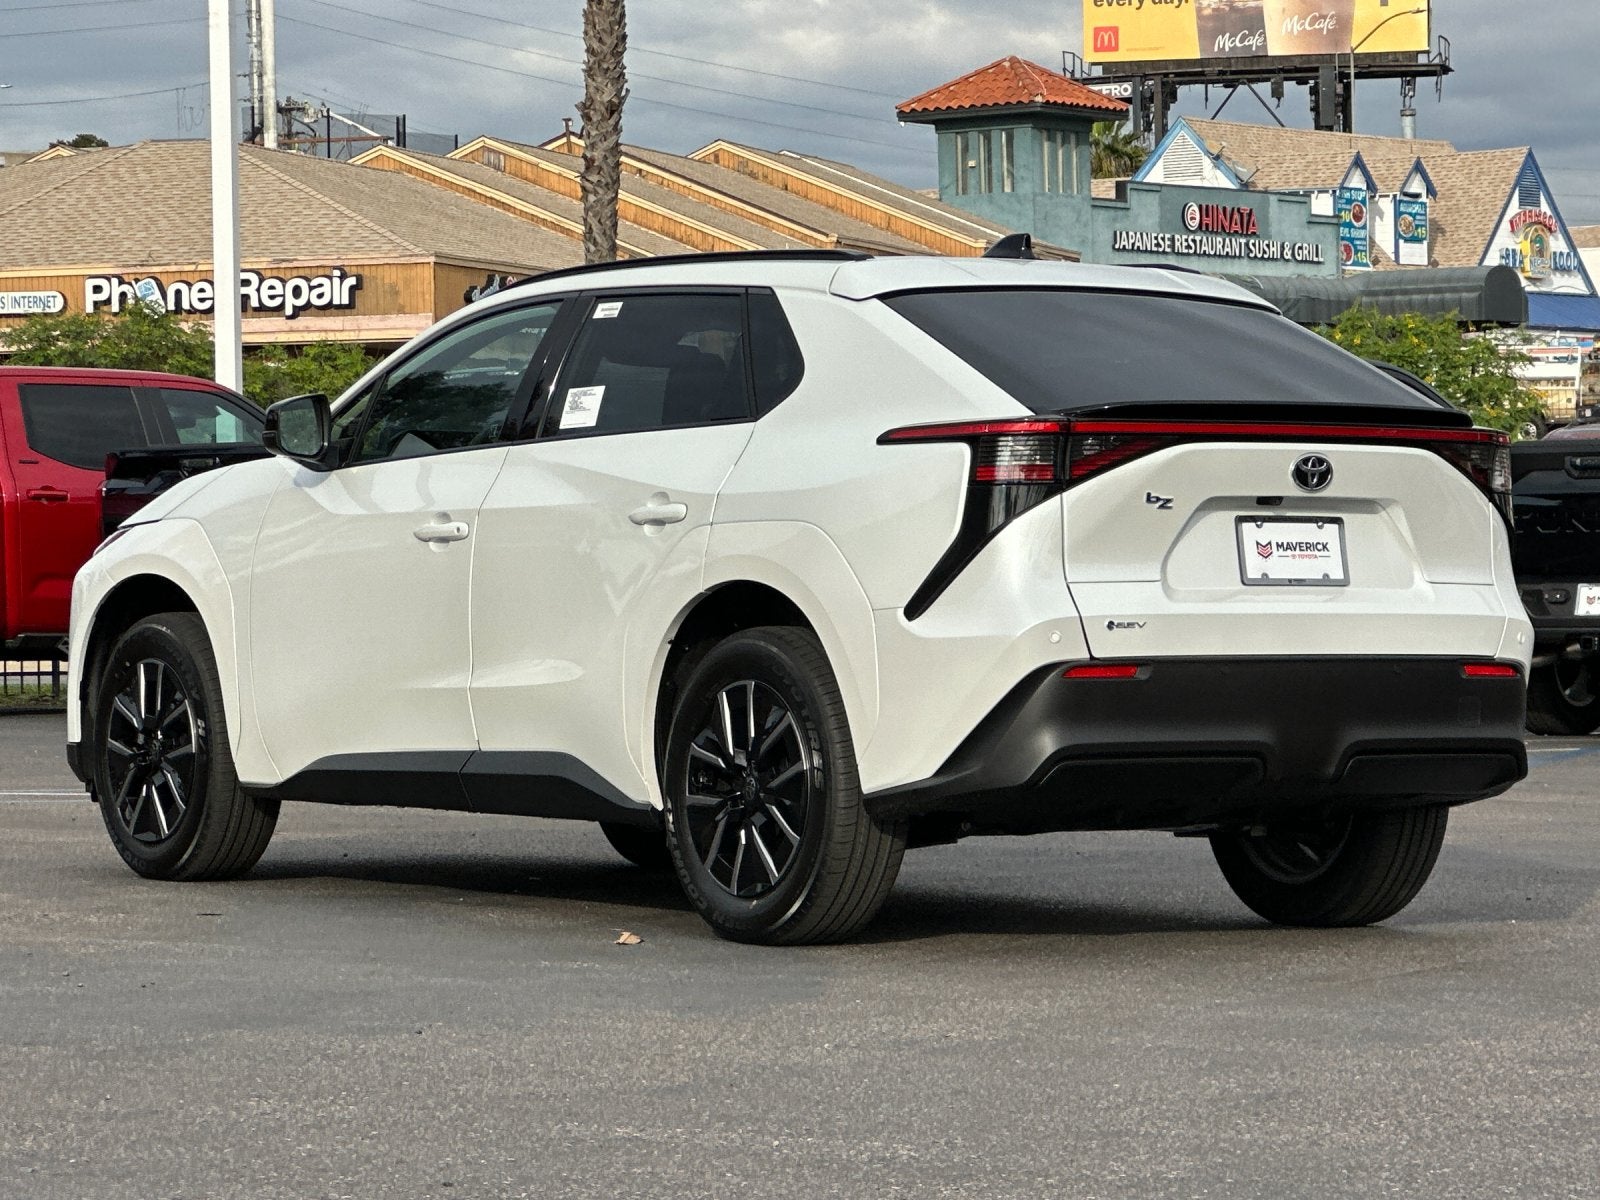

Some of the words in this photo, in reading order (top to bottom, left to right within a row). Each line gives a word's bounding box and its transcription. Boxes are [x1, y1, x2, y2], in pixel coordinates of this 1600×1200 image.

[1281, 11, 1337, 36] McCafé
[1214, 30, 1265, 52] McCafé
[1200, 203, 1259, 234] HINATA
[1114, 231, 1171, 252] JAPANESE
[1174, 233, 1248, 257] RESTAURANT
[1249, 239, 1281, 259] SUSHI
[1283, 241, 1292, 259] &
[1294, 242, 1324, 262] GRILL
[1552, 251, 1581, 271] FOOD
[11, 295, 58, 309] INTERNET
[240, 269, 357, 316] Repair
[1275, 541, 1330, 553] MAVERICK
